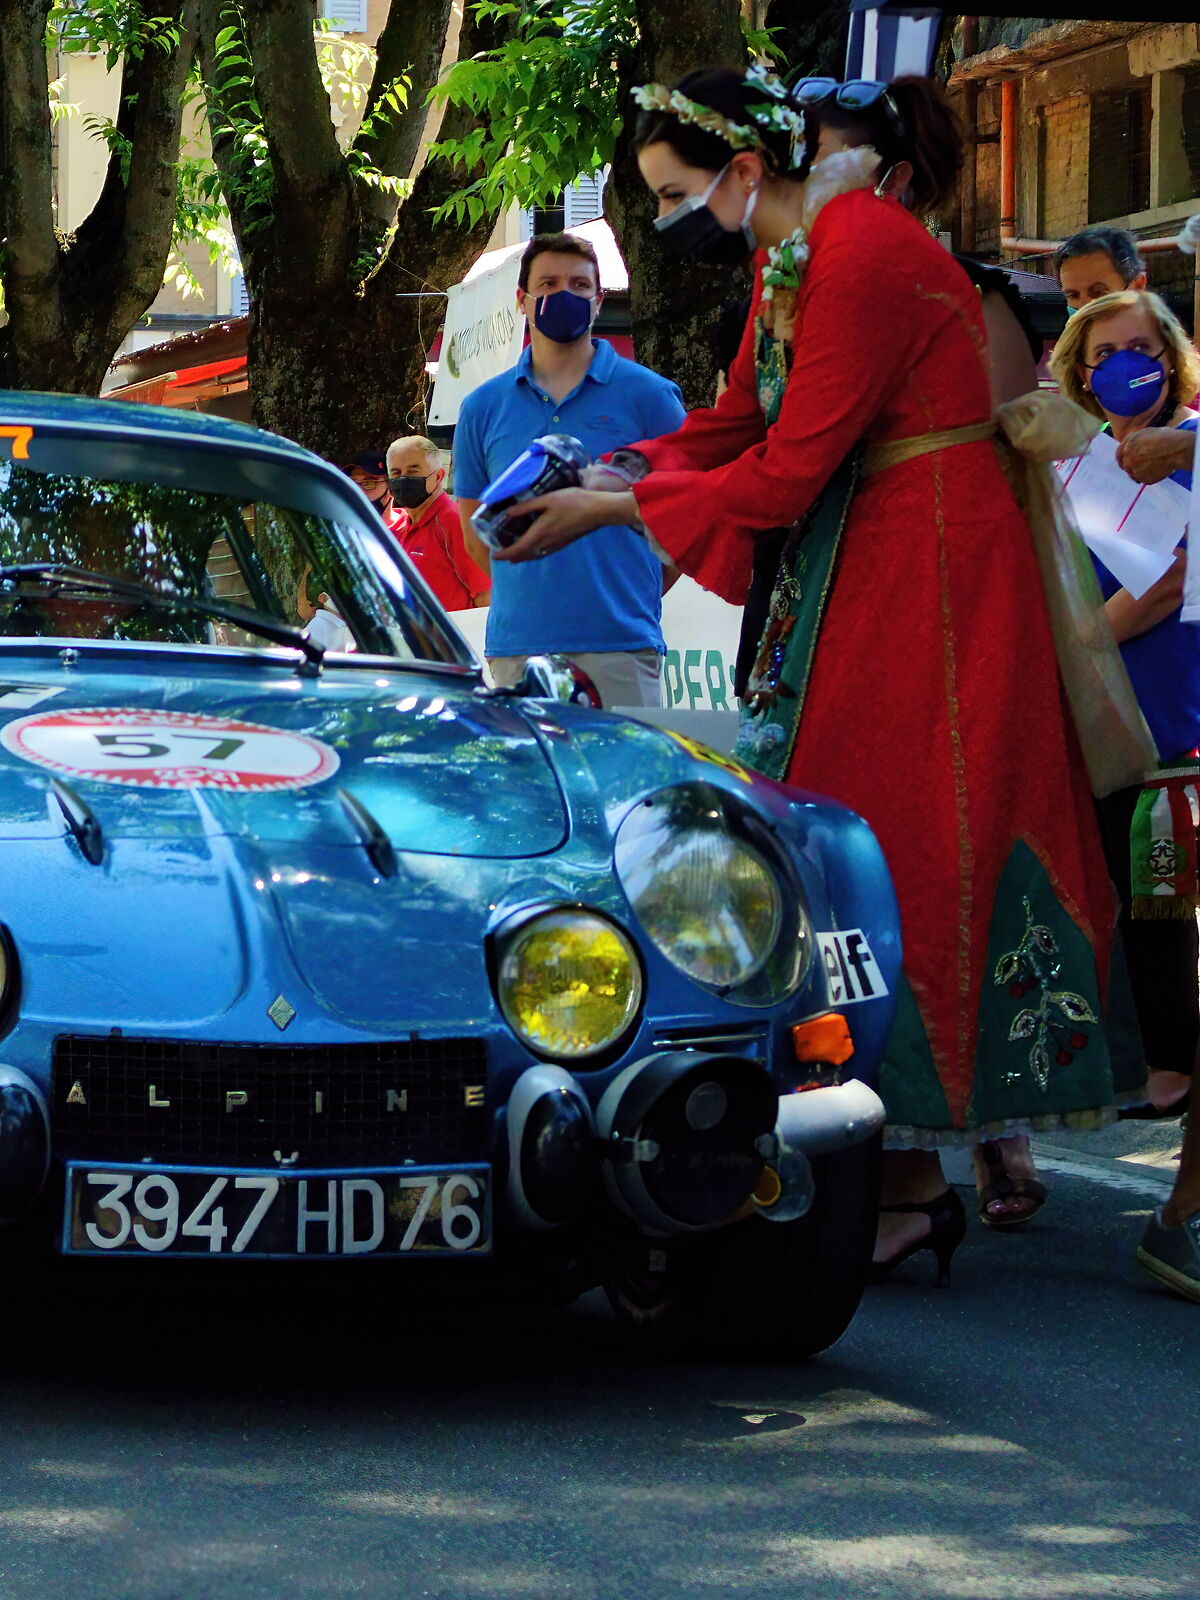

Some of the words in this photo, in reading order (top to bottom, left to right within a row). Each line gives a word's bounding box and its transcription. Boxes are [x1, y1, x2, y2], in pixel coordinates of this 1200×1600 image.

[93, 733, 246, 760] 57
[152, 767, 241, 784] 2021
[823, 934, 875, 1002] elf
[85, 1173, 280, 1253] 3947
[297, 1179, 385, 1254] HD
[399, 1175, 481, 1251] 76
